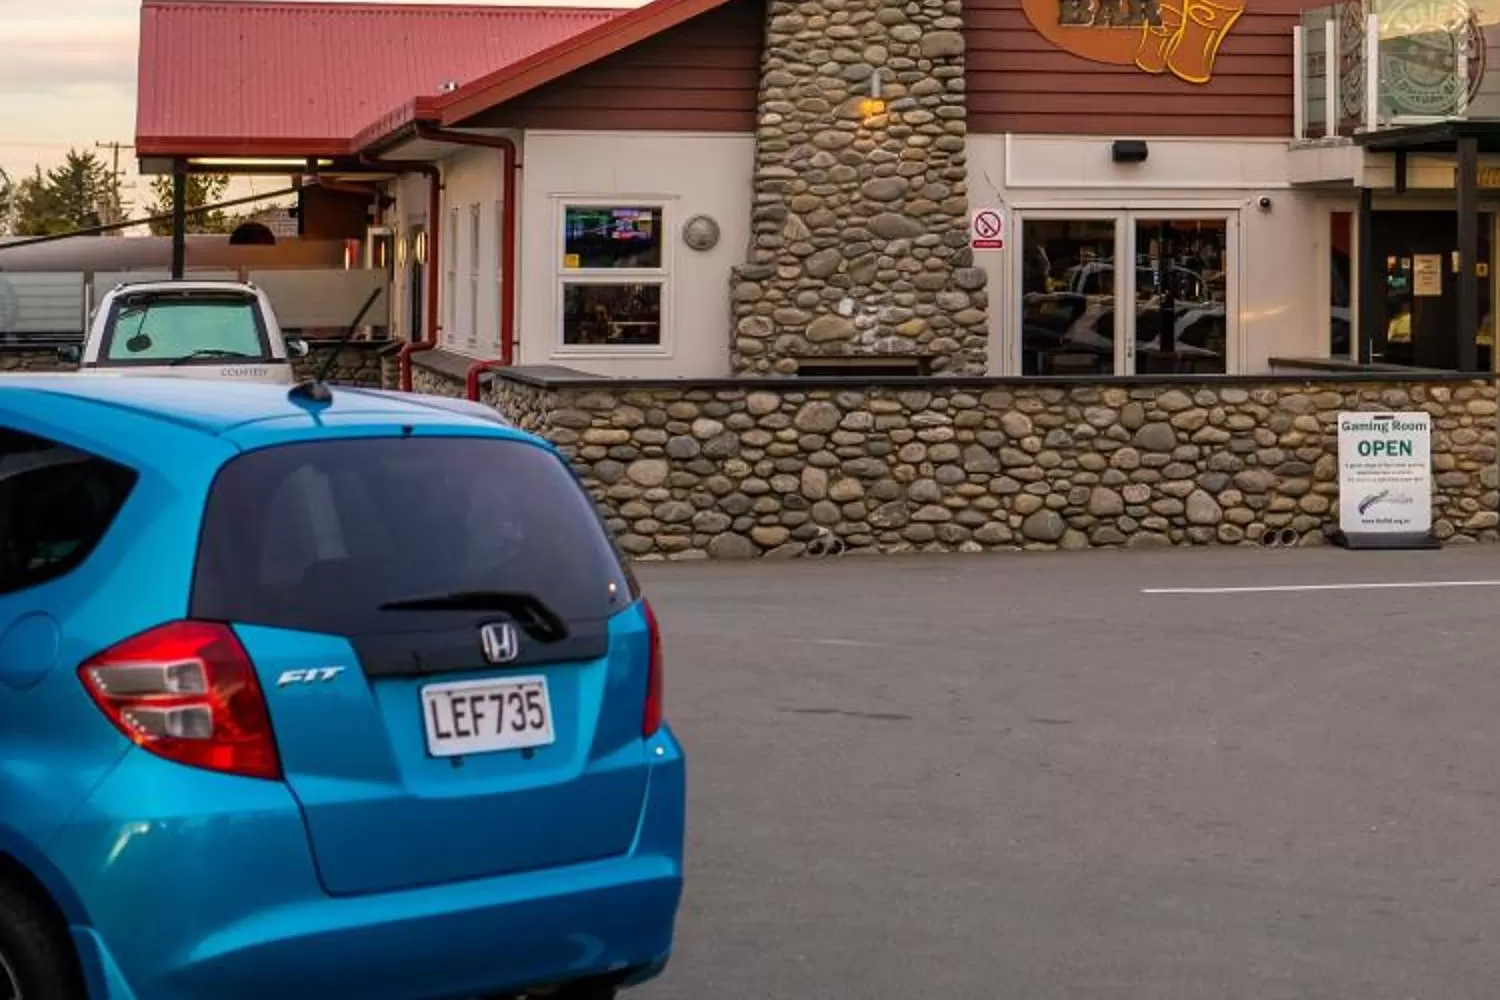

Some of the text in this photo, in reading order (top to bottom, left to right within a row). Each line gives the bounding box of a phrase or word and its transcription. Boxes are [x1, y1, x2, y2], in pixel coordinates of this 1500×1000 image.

[1341, 421, 1427, 434] Gaming Room
[1357, 440, 1412, 456] OPEN
[276, 665, 346, 686] FIT
[430, 690, 545, 739] LEF735
